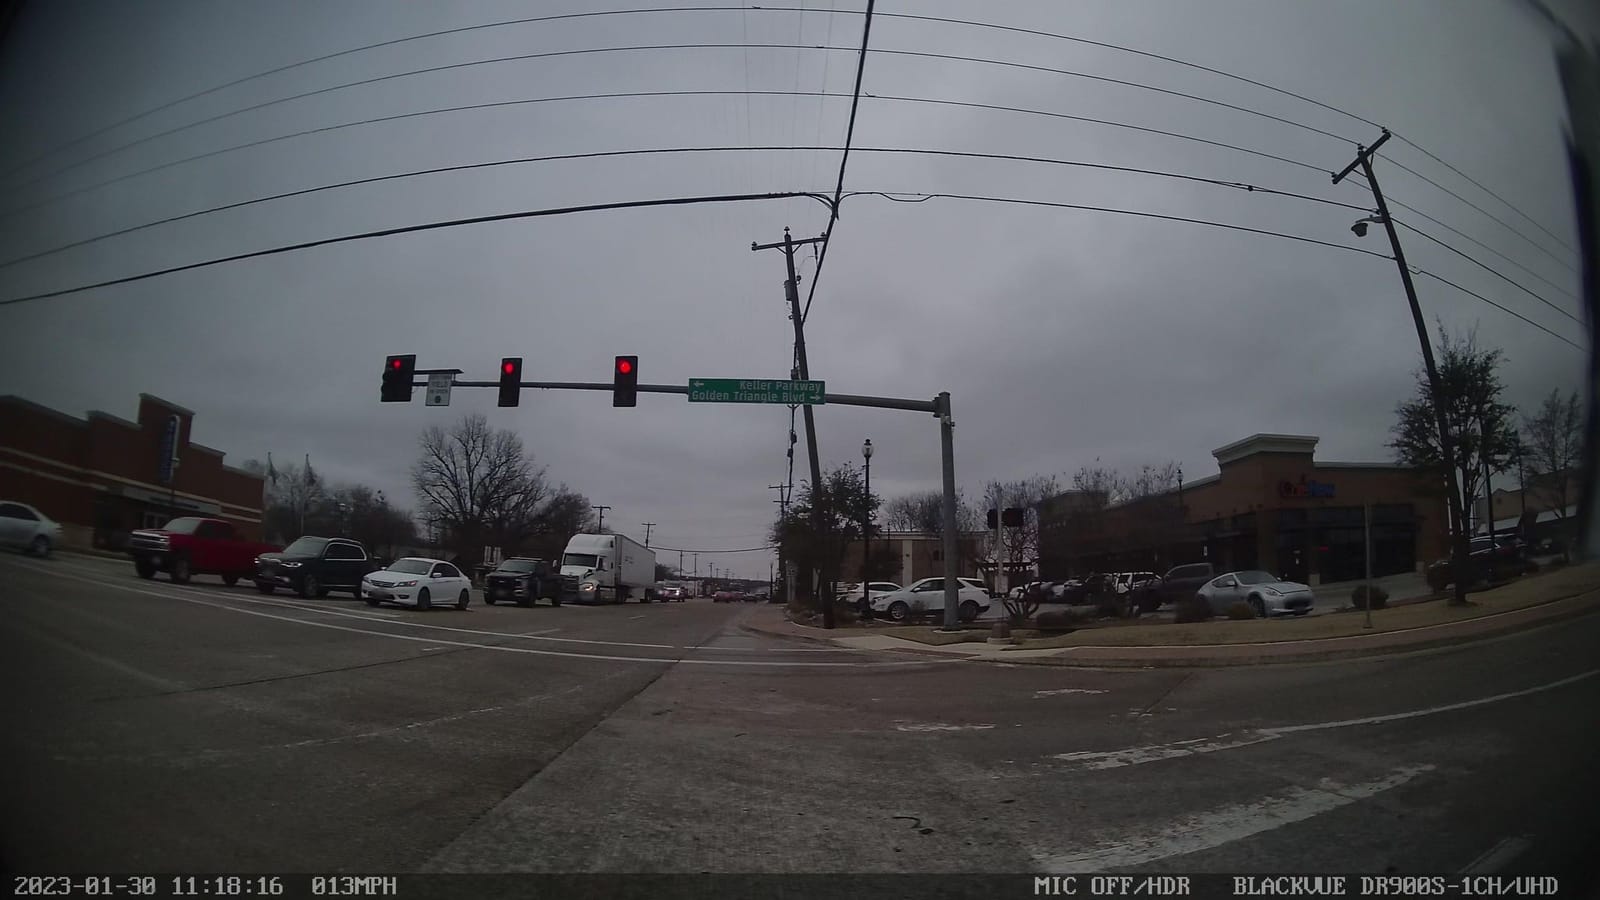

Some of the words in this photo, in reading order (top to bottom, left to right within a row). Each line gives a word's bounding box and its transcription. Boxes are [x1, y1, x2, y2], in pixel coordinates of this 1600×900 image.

[740, 381, 771, 391] Keller
[776, 381, 821, 394] Parkway
[692, 390, 729, 400] Golden
[734, 391, 777, 403] Triangle
[782, 392, 805, 402] Blvd
